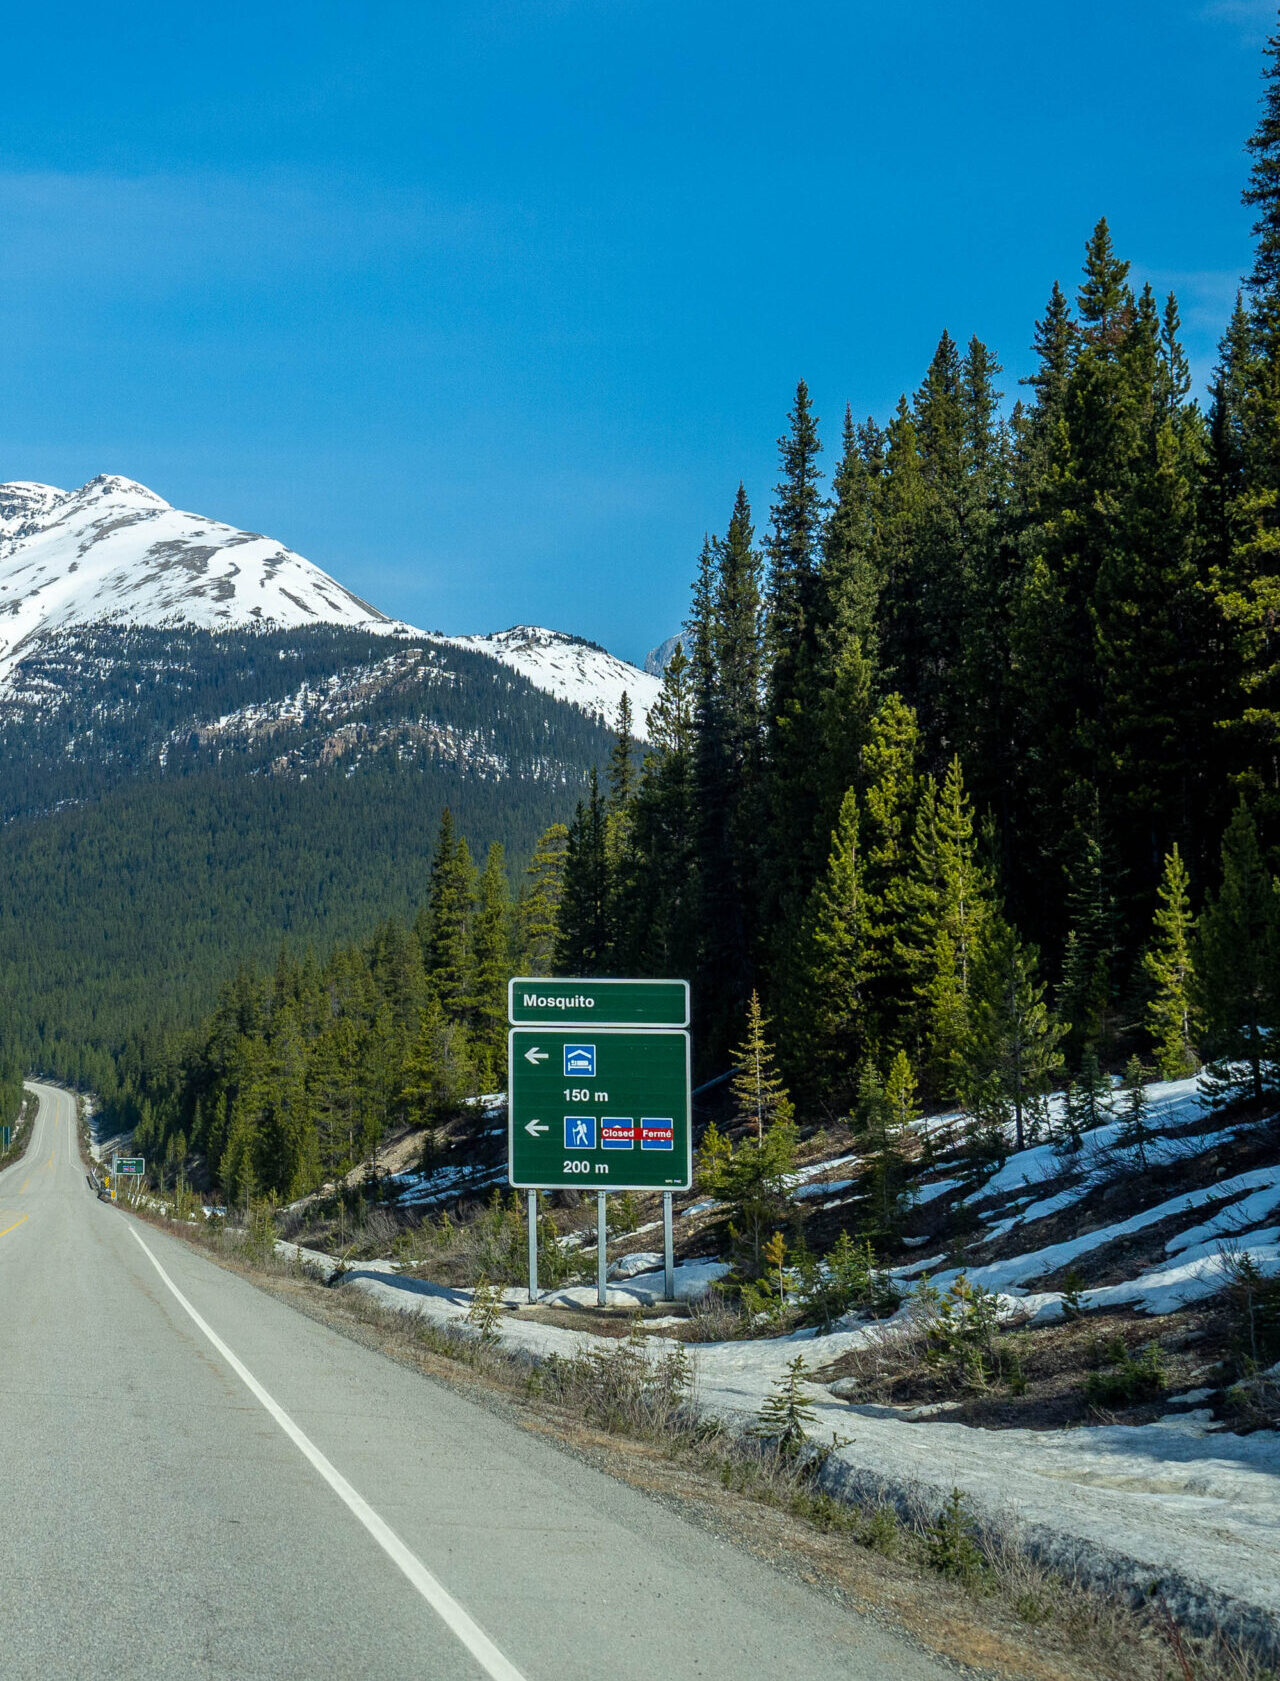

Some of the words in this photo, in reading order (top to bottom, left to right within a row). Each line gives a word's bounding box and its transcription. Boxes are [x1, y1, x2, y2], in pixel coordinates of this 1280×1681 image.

[523, 994, 595, 1009] Mosquito
[564, 1089, 589, 1101] 150
[595, 1092, 608, 1101] m
[602, 1129, 634, 1137] Closed
[642, 1129, 672, 1138] Fermé
[563, 1161, 589, 1173] 200
[595, 1164, 608, 1173] m
